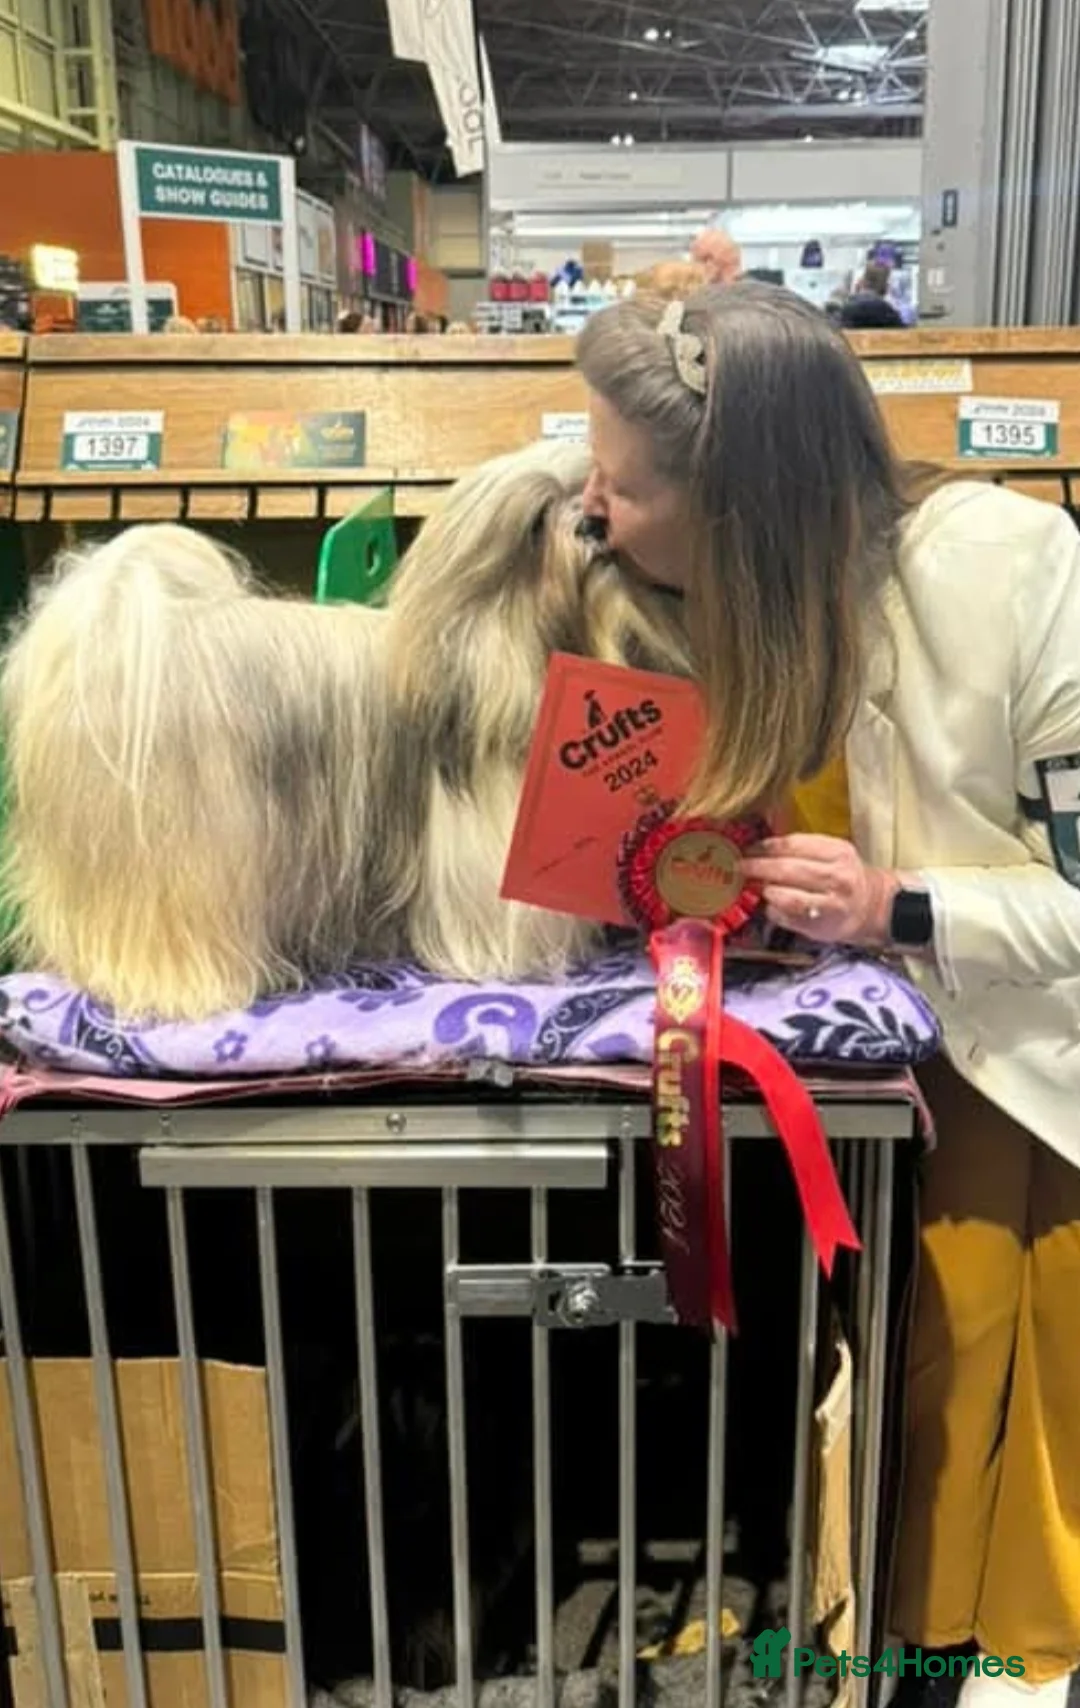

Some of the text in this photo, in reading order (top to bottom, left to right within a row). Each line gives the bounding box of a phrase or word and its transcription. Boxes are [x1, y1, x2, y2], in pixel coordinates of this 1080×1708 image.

[152, 162, 269, 188] CATALOGUES &
[154, 185, 269, 210] SHOW GUIDES
[87, 436, 139, 457] 1397
[982, 424, 1036, 446] 1395
[560, 699, 662, 770] Crufts
[603, 749, 659, 793] 2024
[656, 1028, 699, 1148] Crufts
